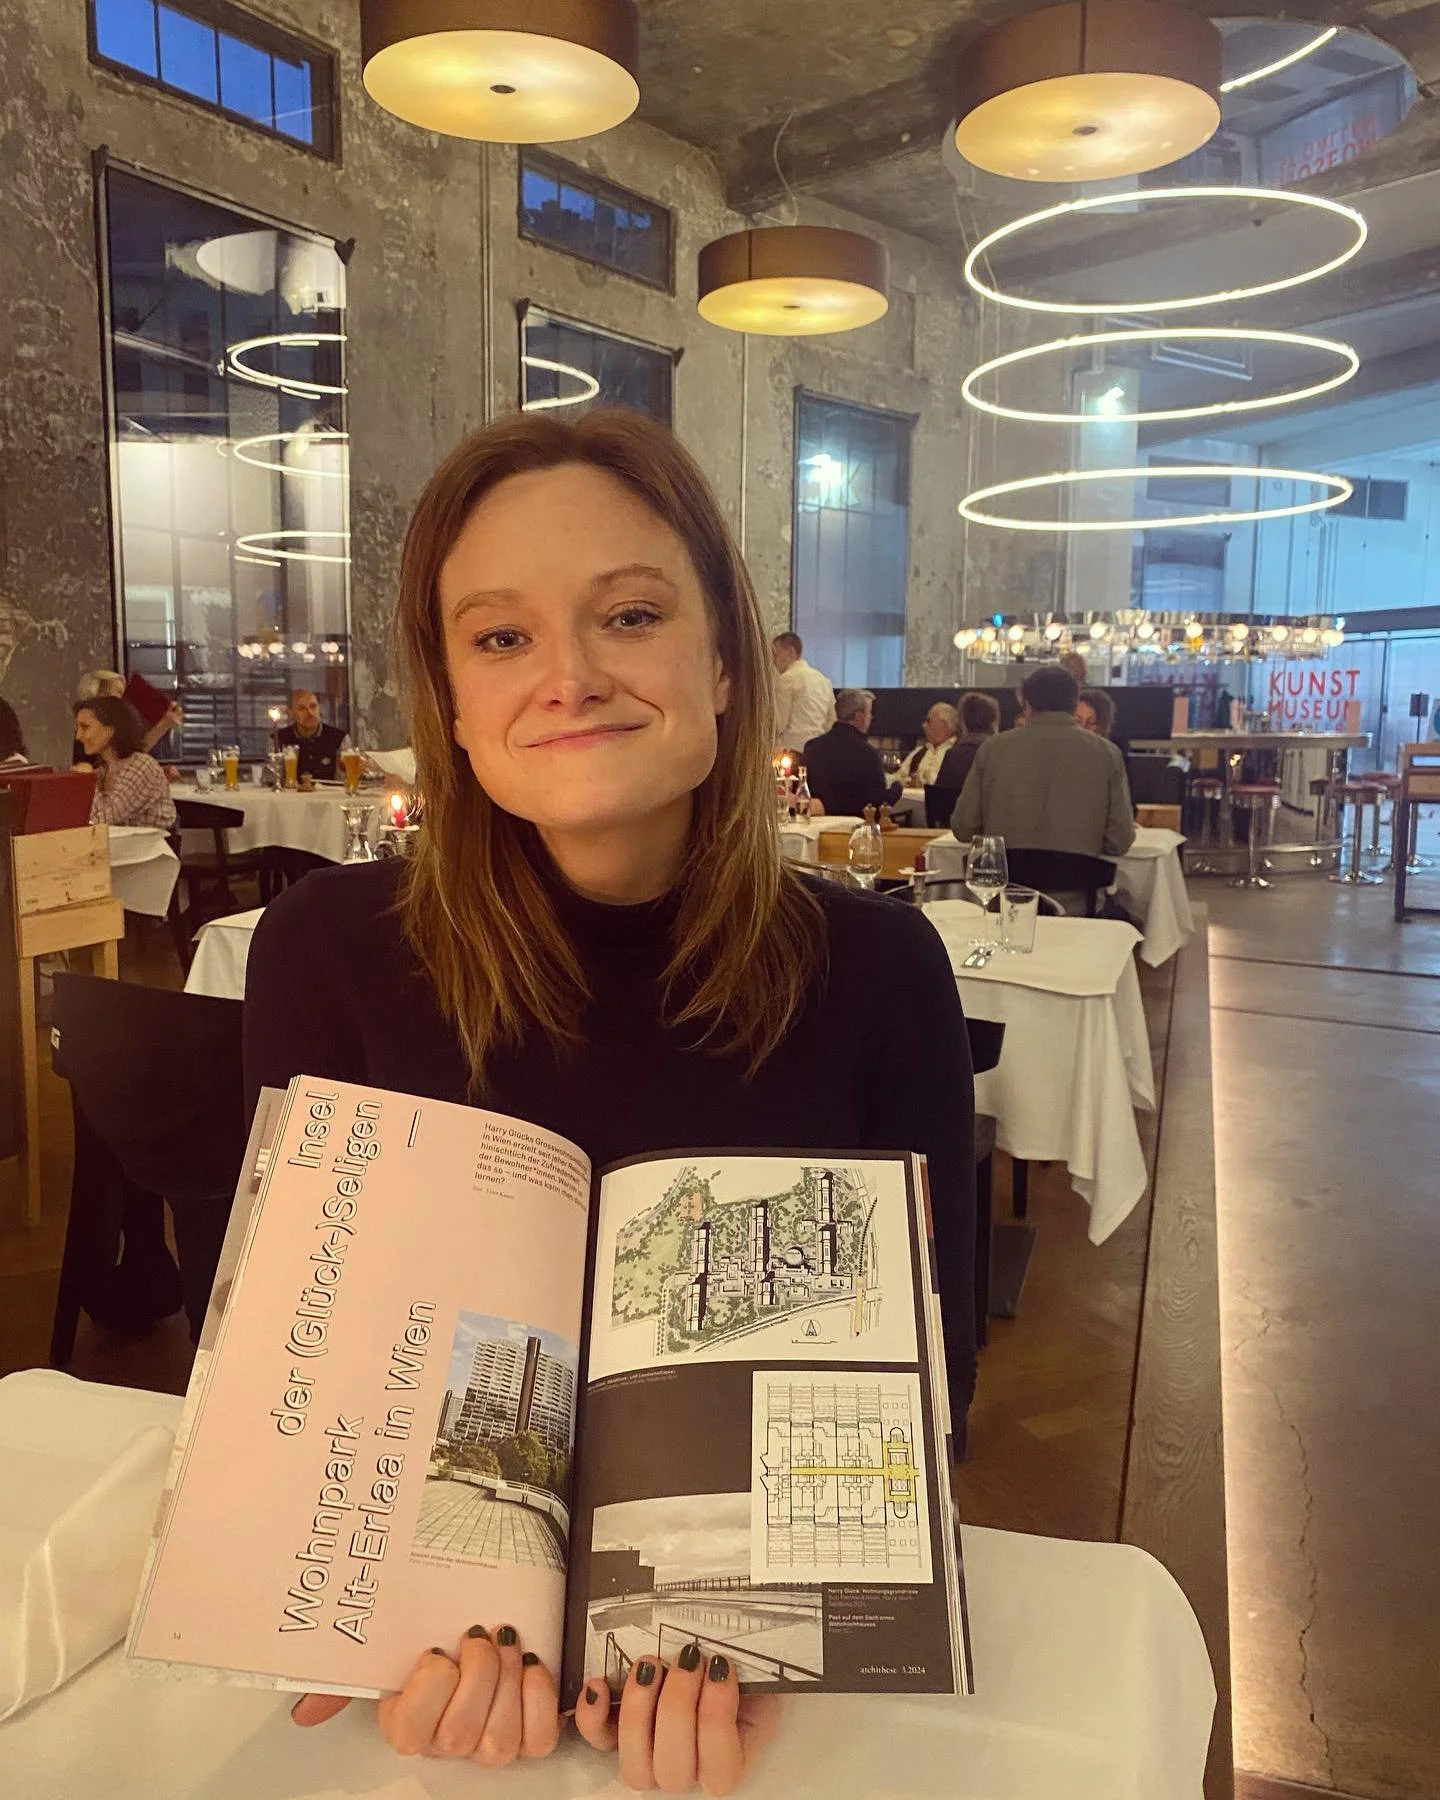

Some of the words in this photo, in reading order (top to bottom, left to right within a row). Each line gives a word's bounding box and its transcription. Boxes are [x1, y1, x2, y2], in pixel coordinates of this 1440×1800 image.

[1269, 669, 1360, 697] KUNST
[288, 1090, 340, 1169] Insel
[482, 1132, 491, 1141] in
[492, 1135, 512, 1146] Wien
[512, 1141, 537, 1155] erzielt
[538, 1149, 551, 1160] seit
[484, 1123, 507, 1136] Harry
[508, 1129, 534, 1143] Glücks
[478, 1152, 493, 1162] der
[527, 1155, 541, 1165] der
[474, 1171, 506, 1185] lernen?
[476, 1162, 492, 1172] das
[493, 1166, 504, 1175] so
[512, 1171, 527, 1181] und
[528, 1176, 544, 1187] was
[544, 1182, 561, 1194] kann
[285, 1099, 383, 1358] (Glück-)Seligen
[385, 1300, 437, 1391] Wien
[270, 1367, 316, 1436] der
[375, 1405, 415, 1440] in
[278, 1413, 365, 1633] Wohnpark
[333, 1453, 406, 1645] Alt-Erlaa
